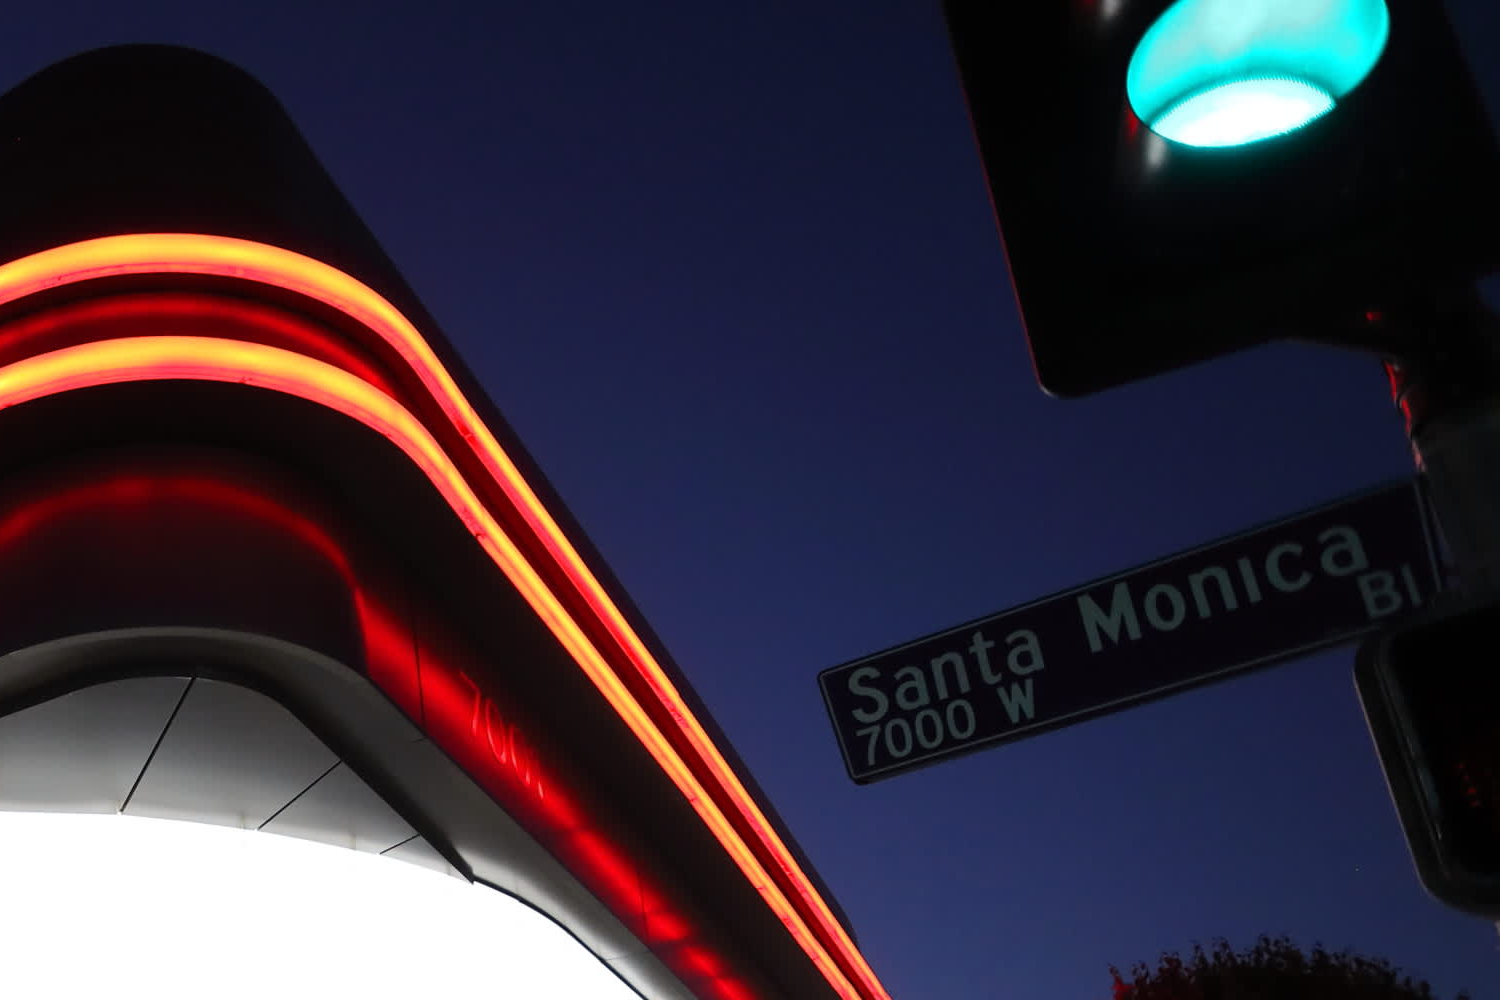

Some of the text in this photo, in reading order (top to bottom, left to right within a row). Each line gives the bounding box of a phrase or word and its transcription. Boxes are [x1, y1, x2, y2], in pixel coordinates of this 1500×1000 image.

[847, 524, 1369, 724] Santa Monica
[855, 680, 1036, 766] 7000 W
